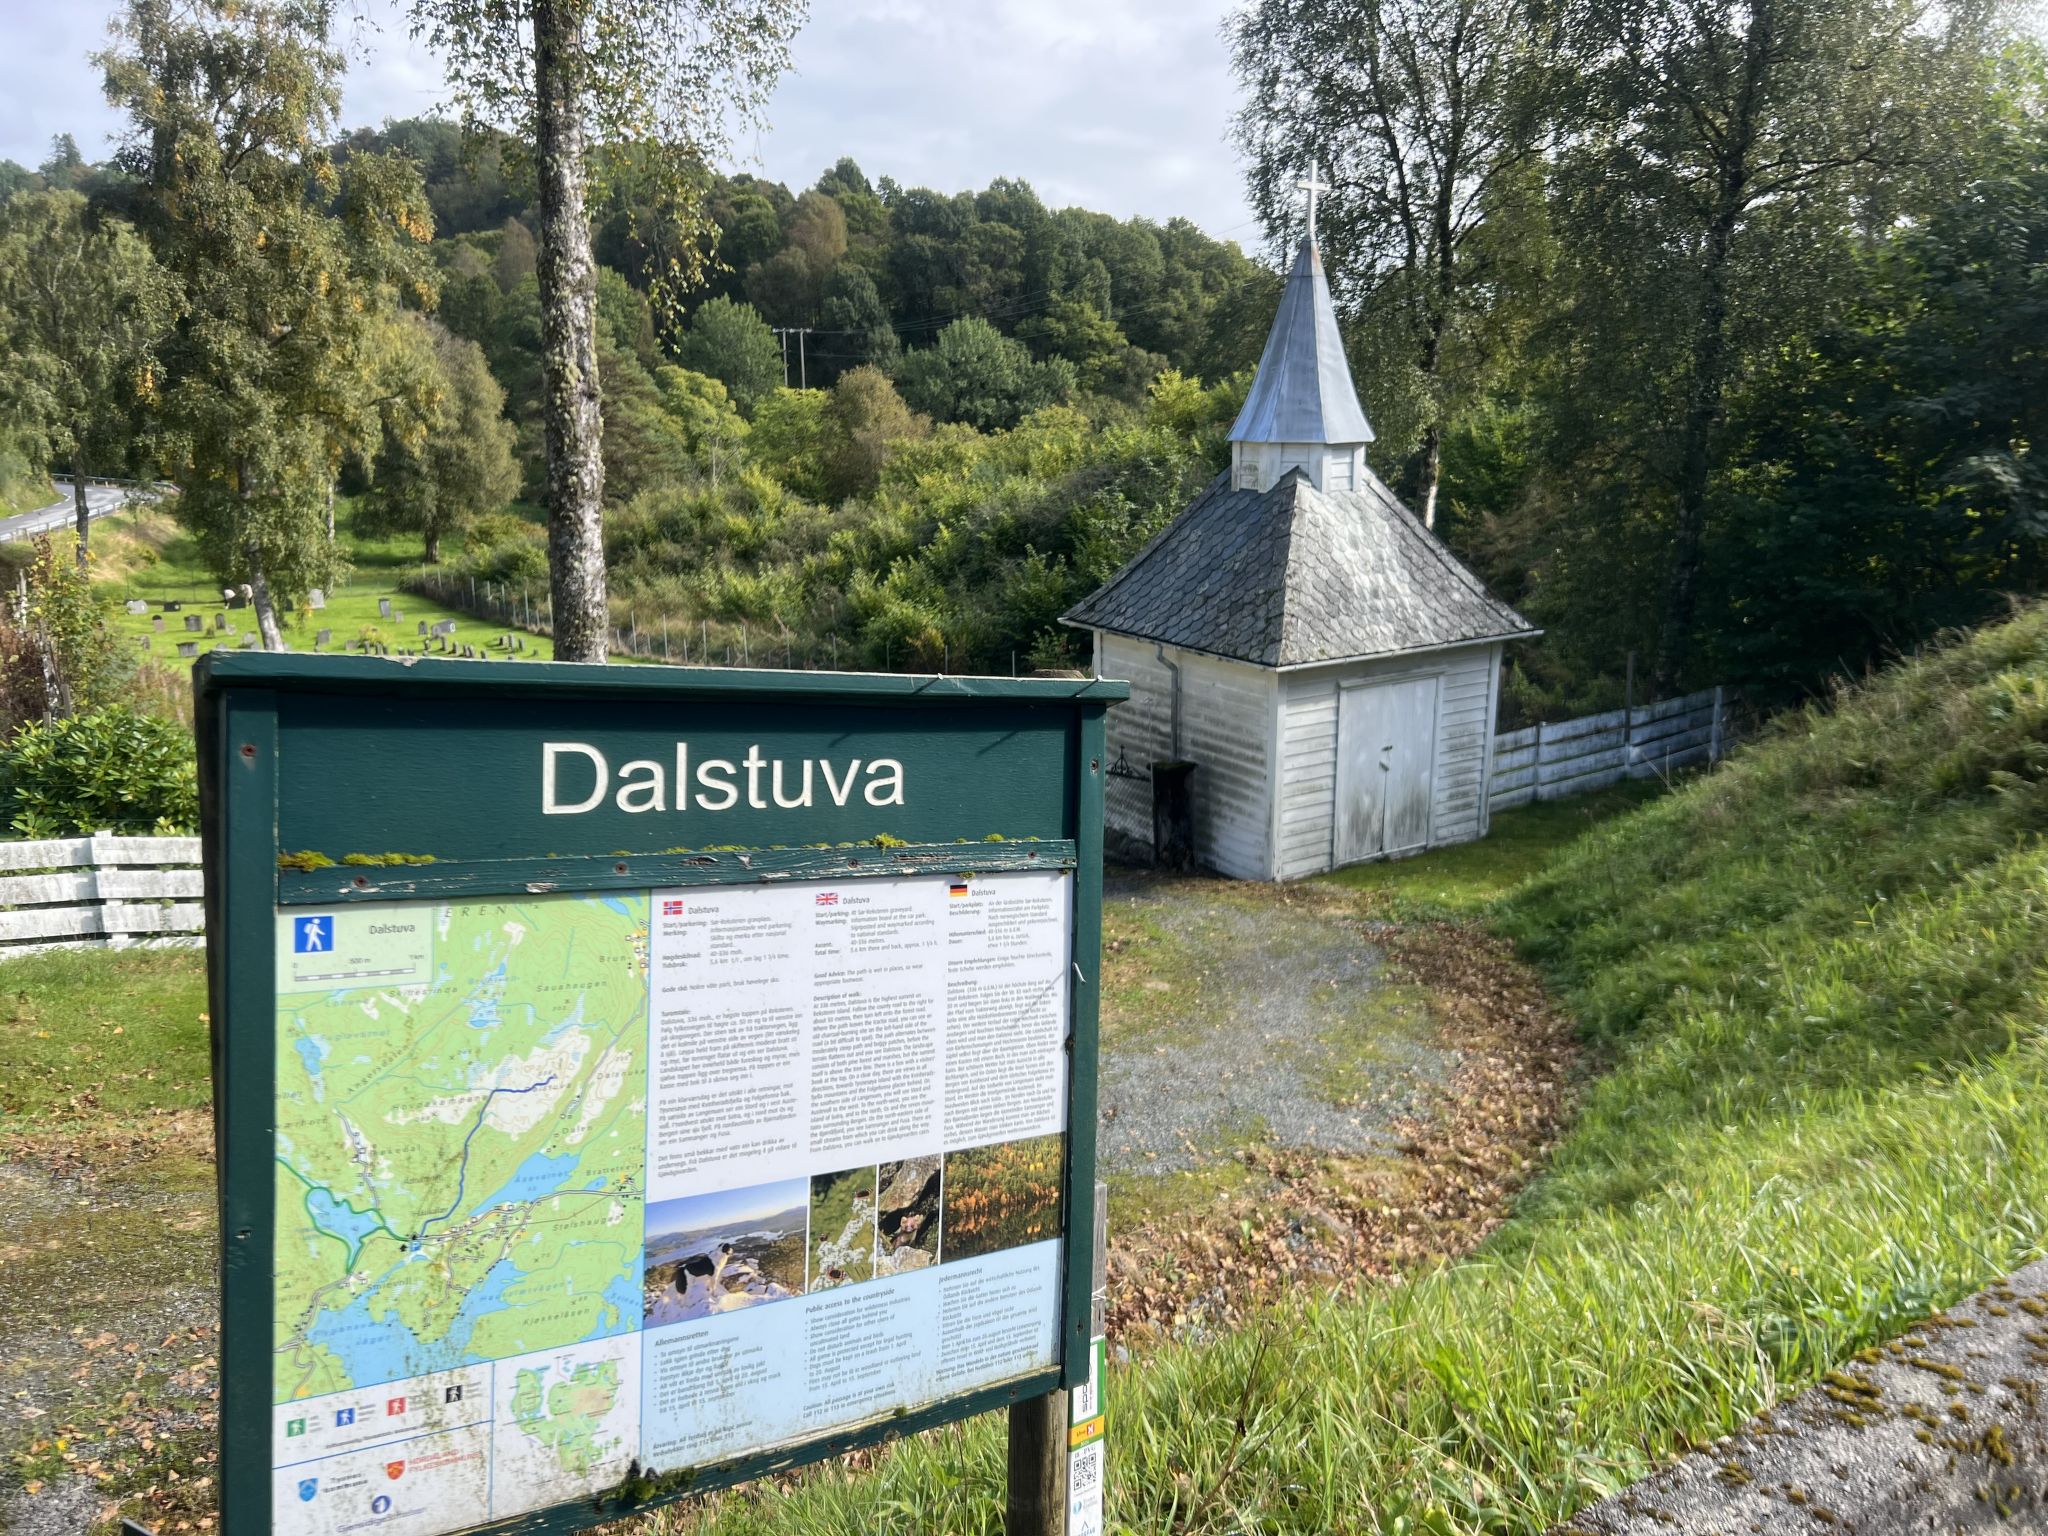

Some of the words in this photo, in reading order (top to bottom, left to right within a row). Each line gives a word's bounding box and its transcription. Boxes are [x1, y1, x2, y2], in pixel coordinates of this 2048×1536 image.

[542, 742, 905, 815] Dalstuva
[971, 888, 995, 897] Dalstuva
[842, 896, 870, 905] Dalstuva
[687, 905, 719, 915] Dalstuva
[369, 922, 415, 935] Dalstuva
[805, 1303, 822, 1314] Public
[824, 1300, 842, 1310] access
[862, 1287, 894, 1303] countryside
[654, 1328, 708, 1350] Allemannsretten
